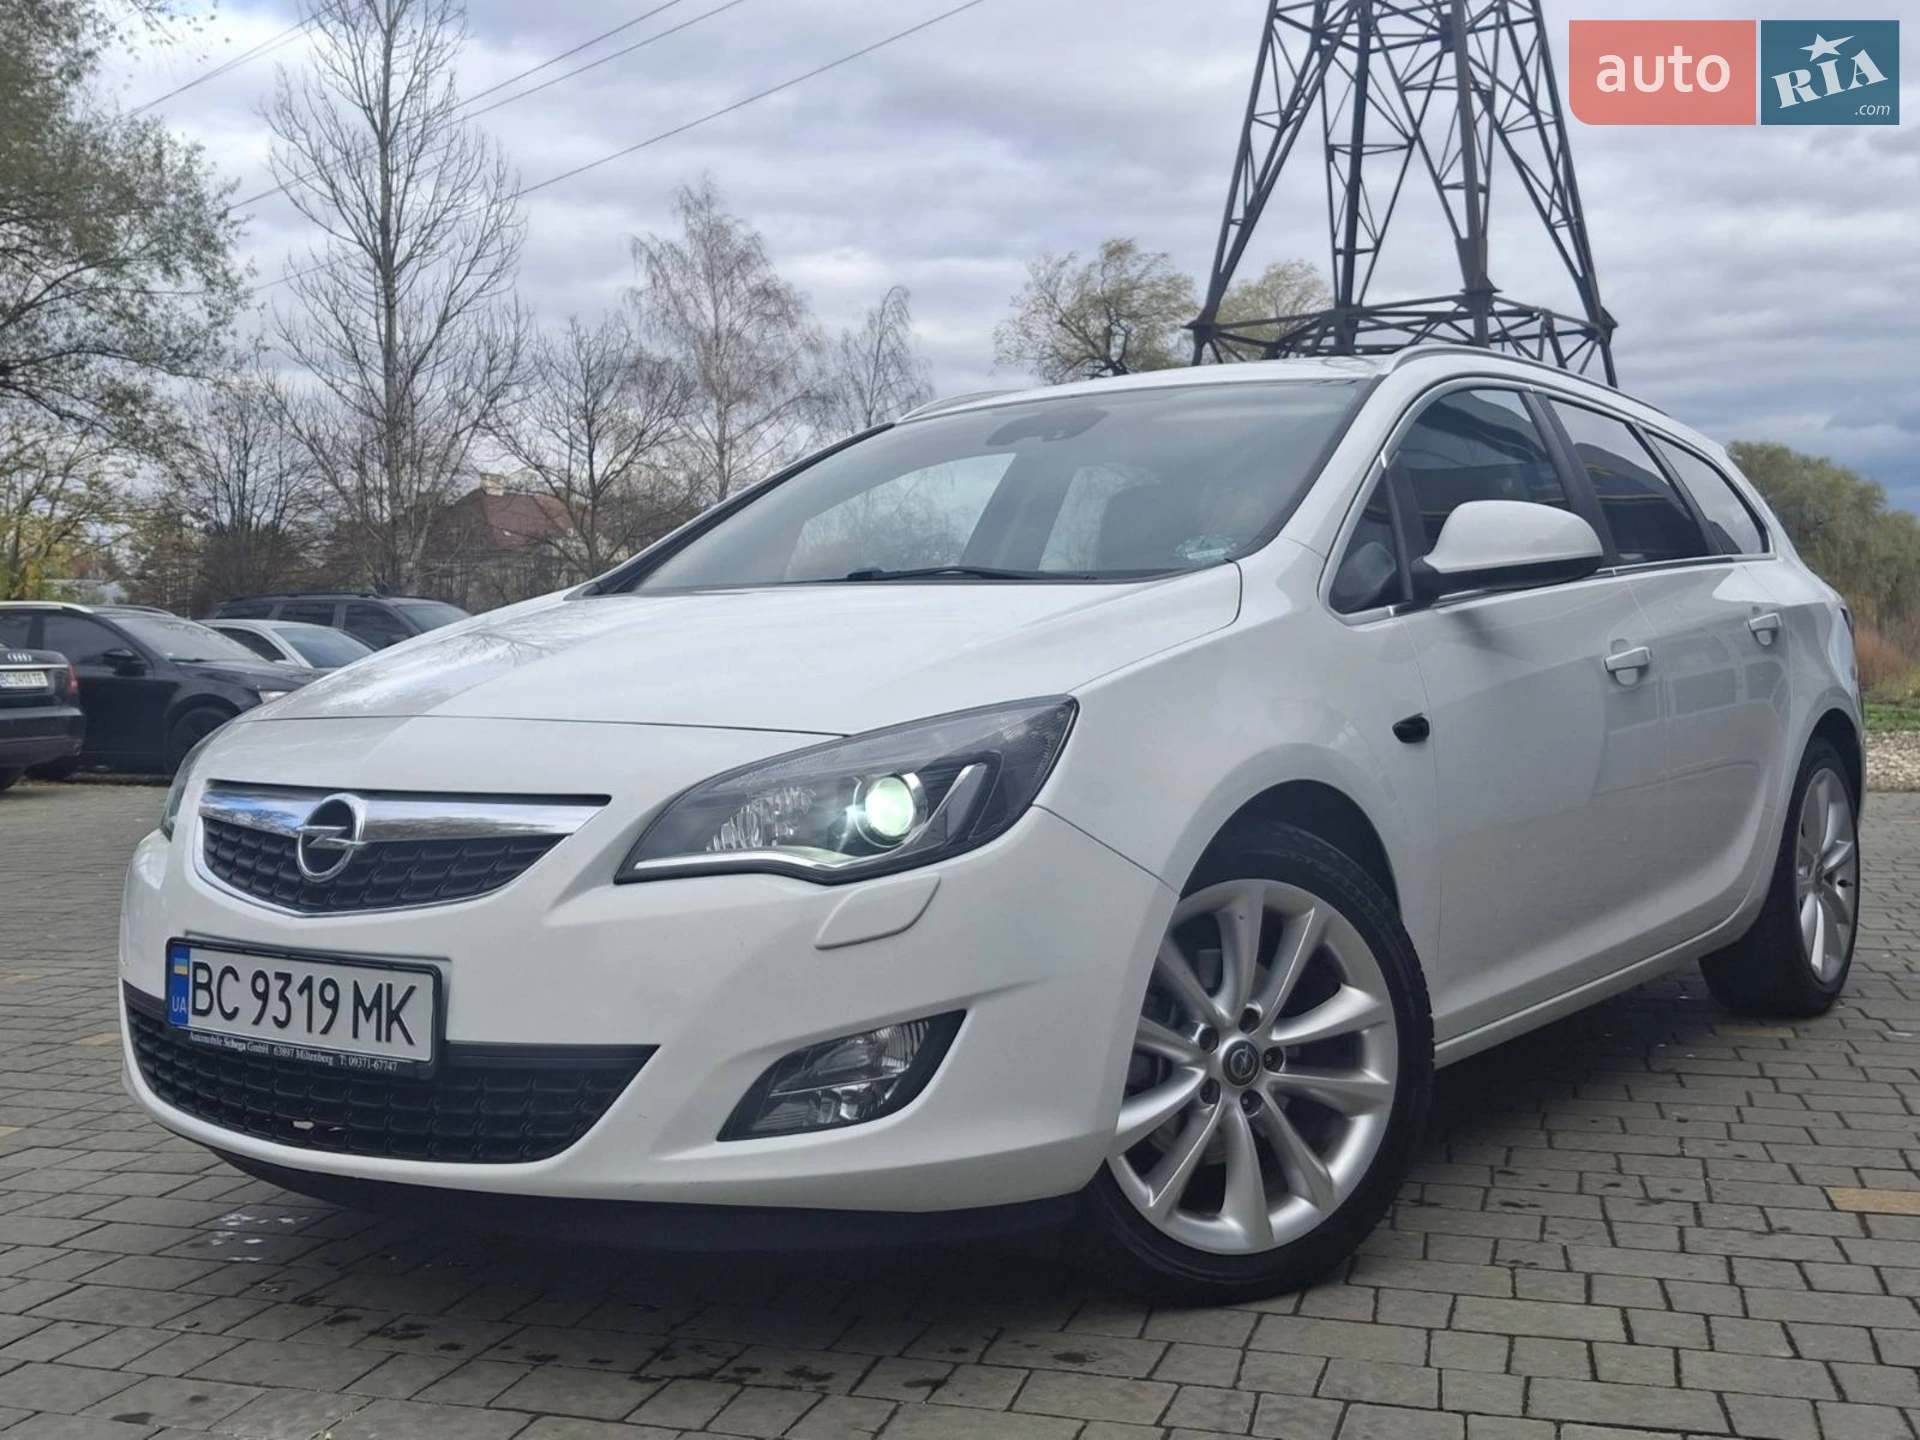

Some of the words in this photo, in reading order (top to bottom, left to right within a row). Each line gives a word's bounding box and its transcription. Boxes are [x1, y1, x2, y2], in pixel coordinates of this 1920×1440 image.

[172, 996, 187, 1013] UA
[191, 961, 240, 1021] BC
[250, 969, 340, 1035] 9319
[352, 979, 417, 1046] MK
[247, 1041, 269, 1054] GmbH
